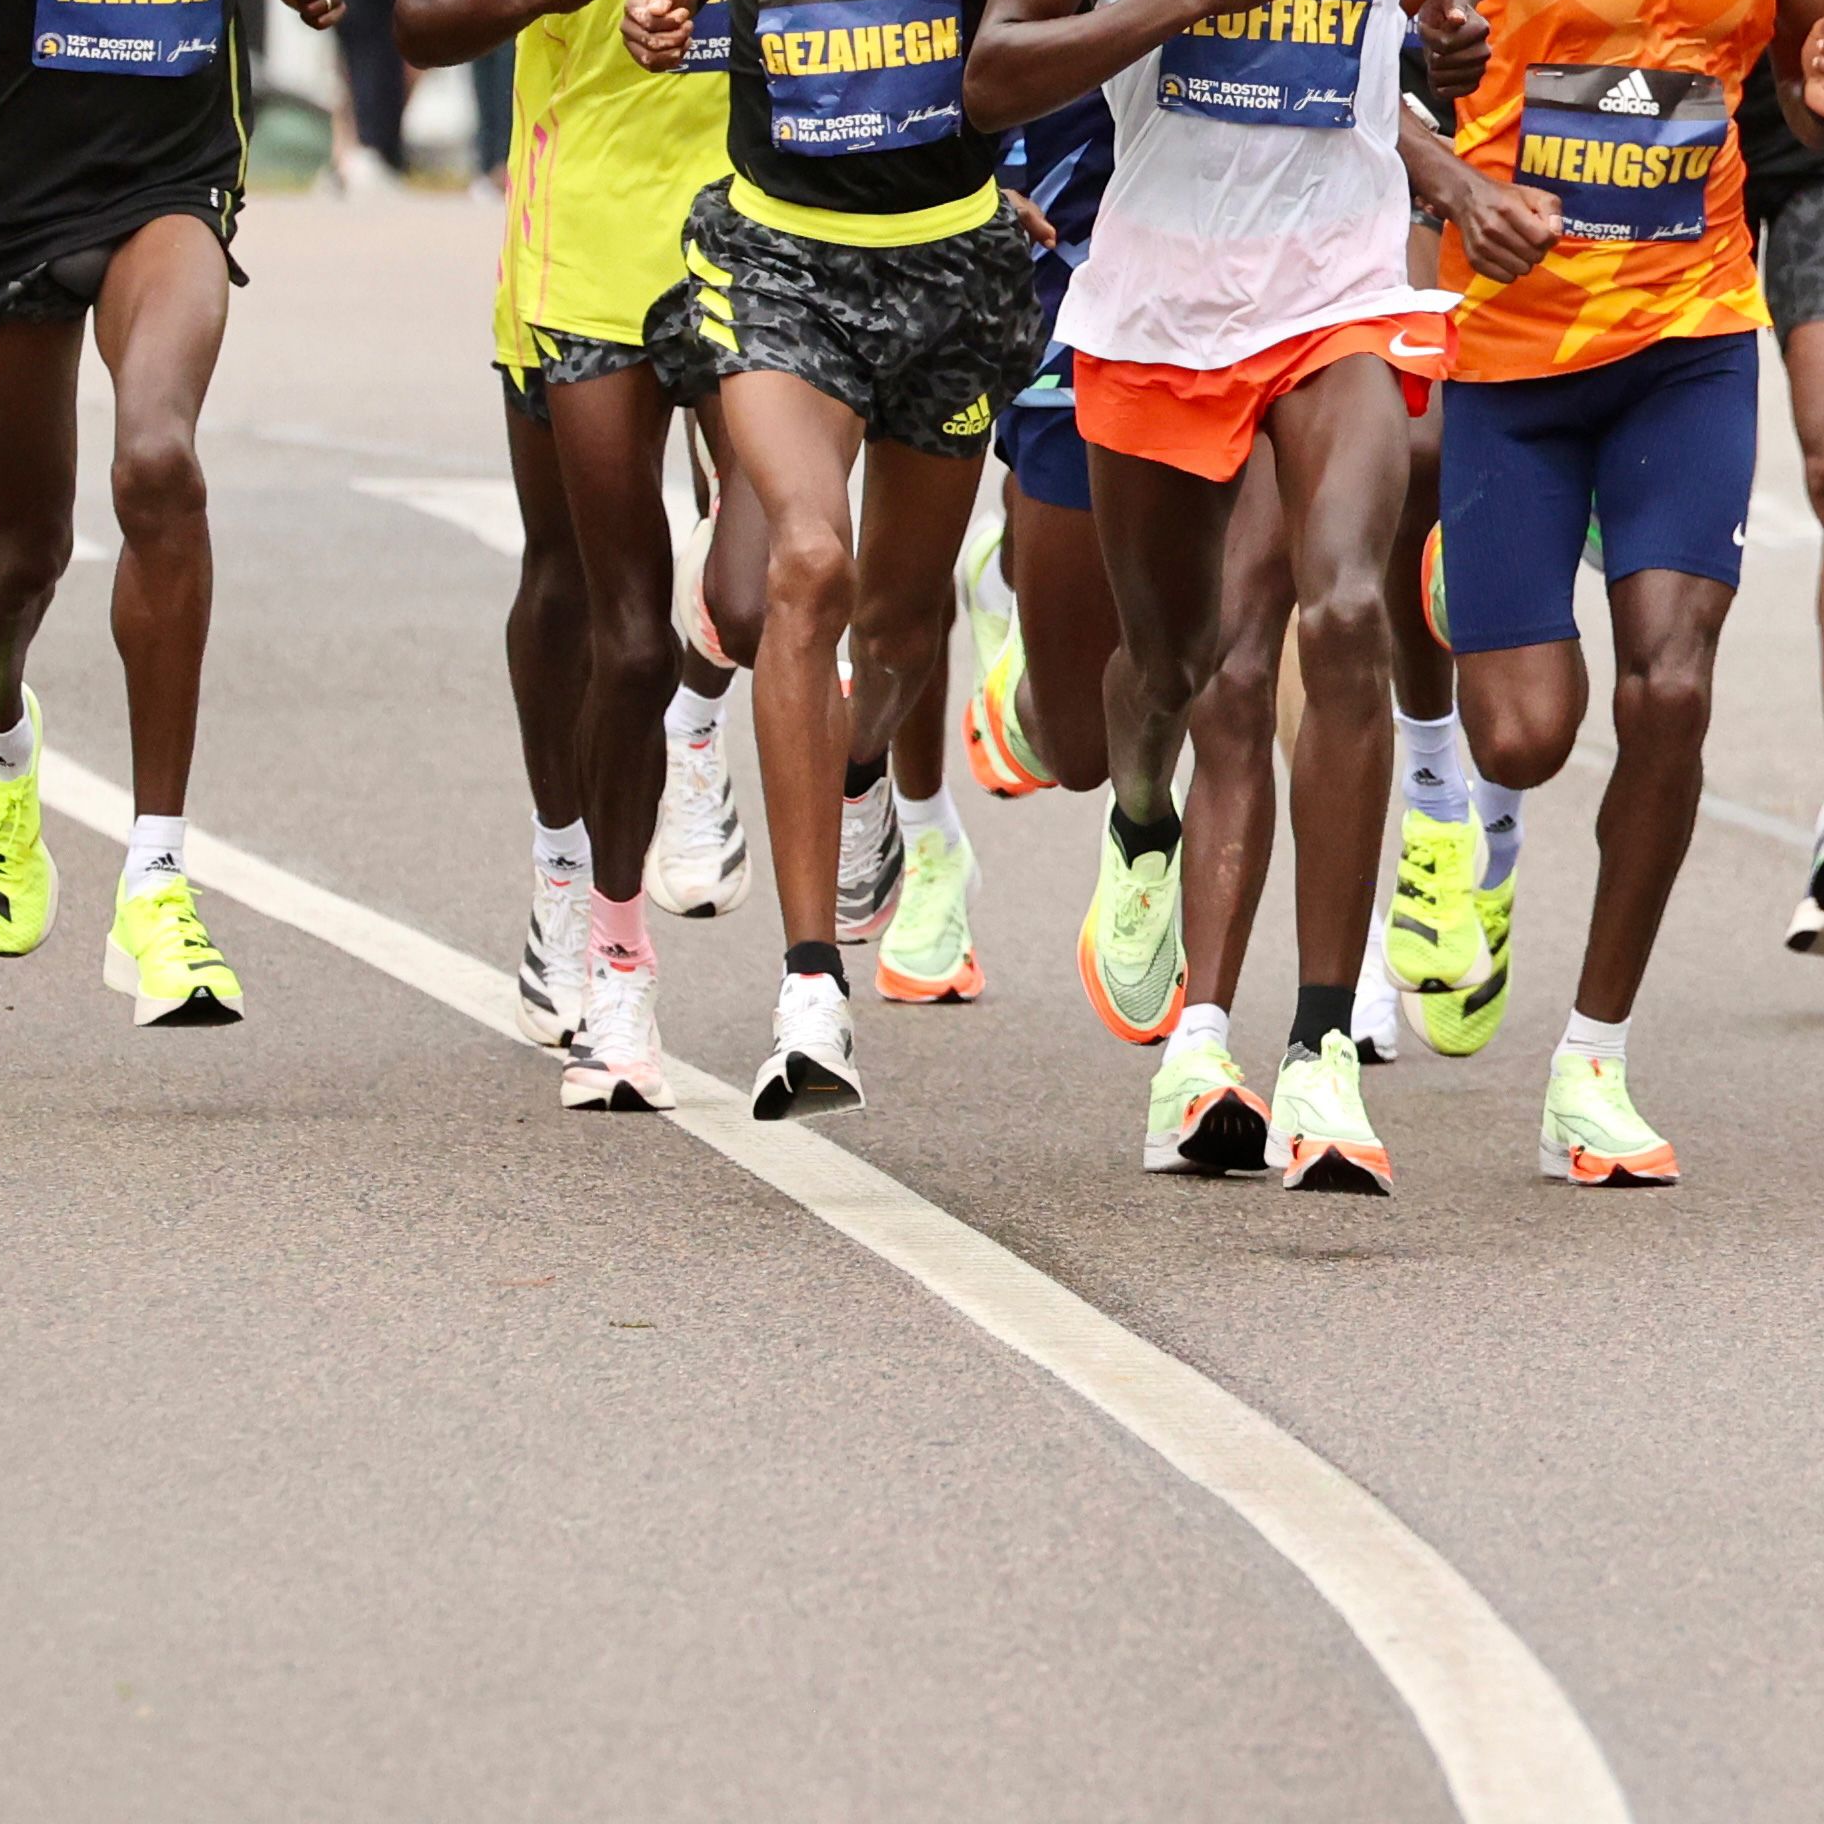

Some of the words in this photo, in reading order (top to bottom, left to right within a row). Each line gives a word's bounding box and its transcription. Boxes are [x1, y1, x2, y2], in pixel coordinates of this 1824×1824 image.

[98, 37, 154, 51] BOSTON
[761, 16, 960, 76] GEZAHEGN
[66, 46, 156, 62] MARATHON
[1188, 77, 1219, 91] 125TH
[1220, 81, 1280, 97] BOSTON
[1187, 89, 1282, 110] MARATHON
[1598, 96, 1660, 116] adidas
[825, 113, 882, 128] BOSTON
[797, 124, 885, 143] MARATHON
[1521, 134, 1718, 189] MENGSTU
[1572, 219, 1631, 235] BOSTON
